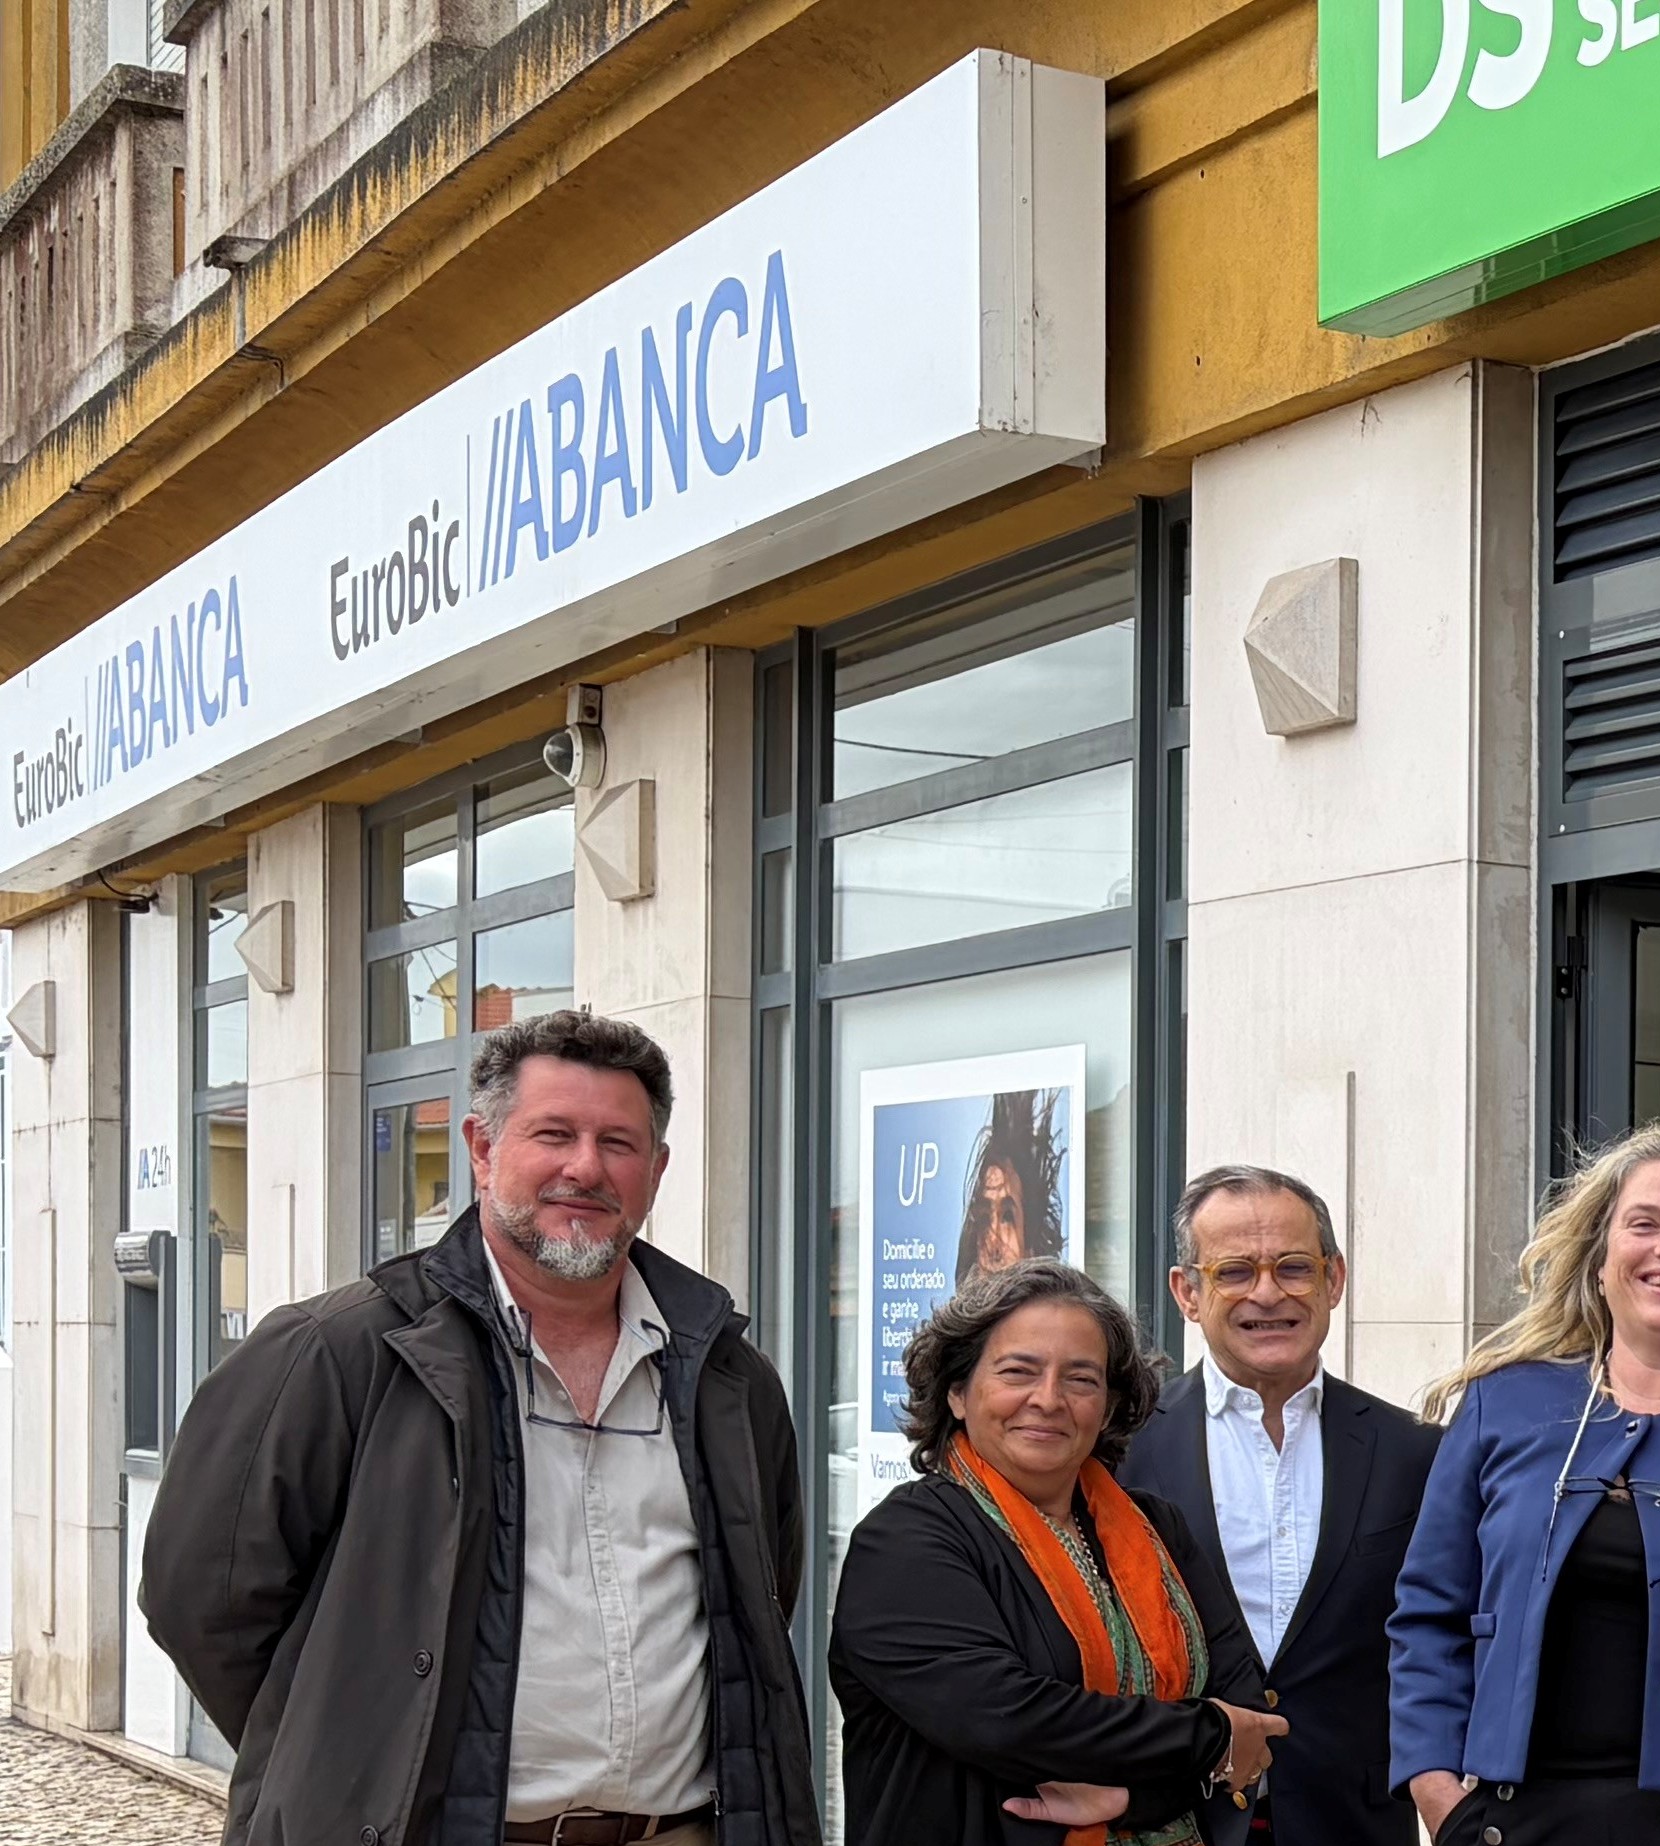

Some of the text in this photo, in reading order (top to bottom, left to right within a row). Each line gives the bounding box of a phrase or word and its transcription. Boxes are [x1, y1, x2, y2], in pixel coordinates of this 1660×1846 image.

[330, 499, 461, 661] EuroBic
[13, 717, 84, 828] EuroBic
[898, 1142, 939, 1207] UP
[883, 1267, 945, 1290] seu ordenado
[882, 1302, 889, 1319] e
[871, 1453, 908, 1481] Vamos
